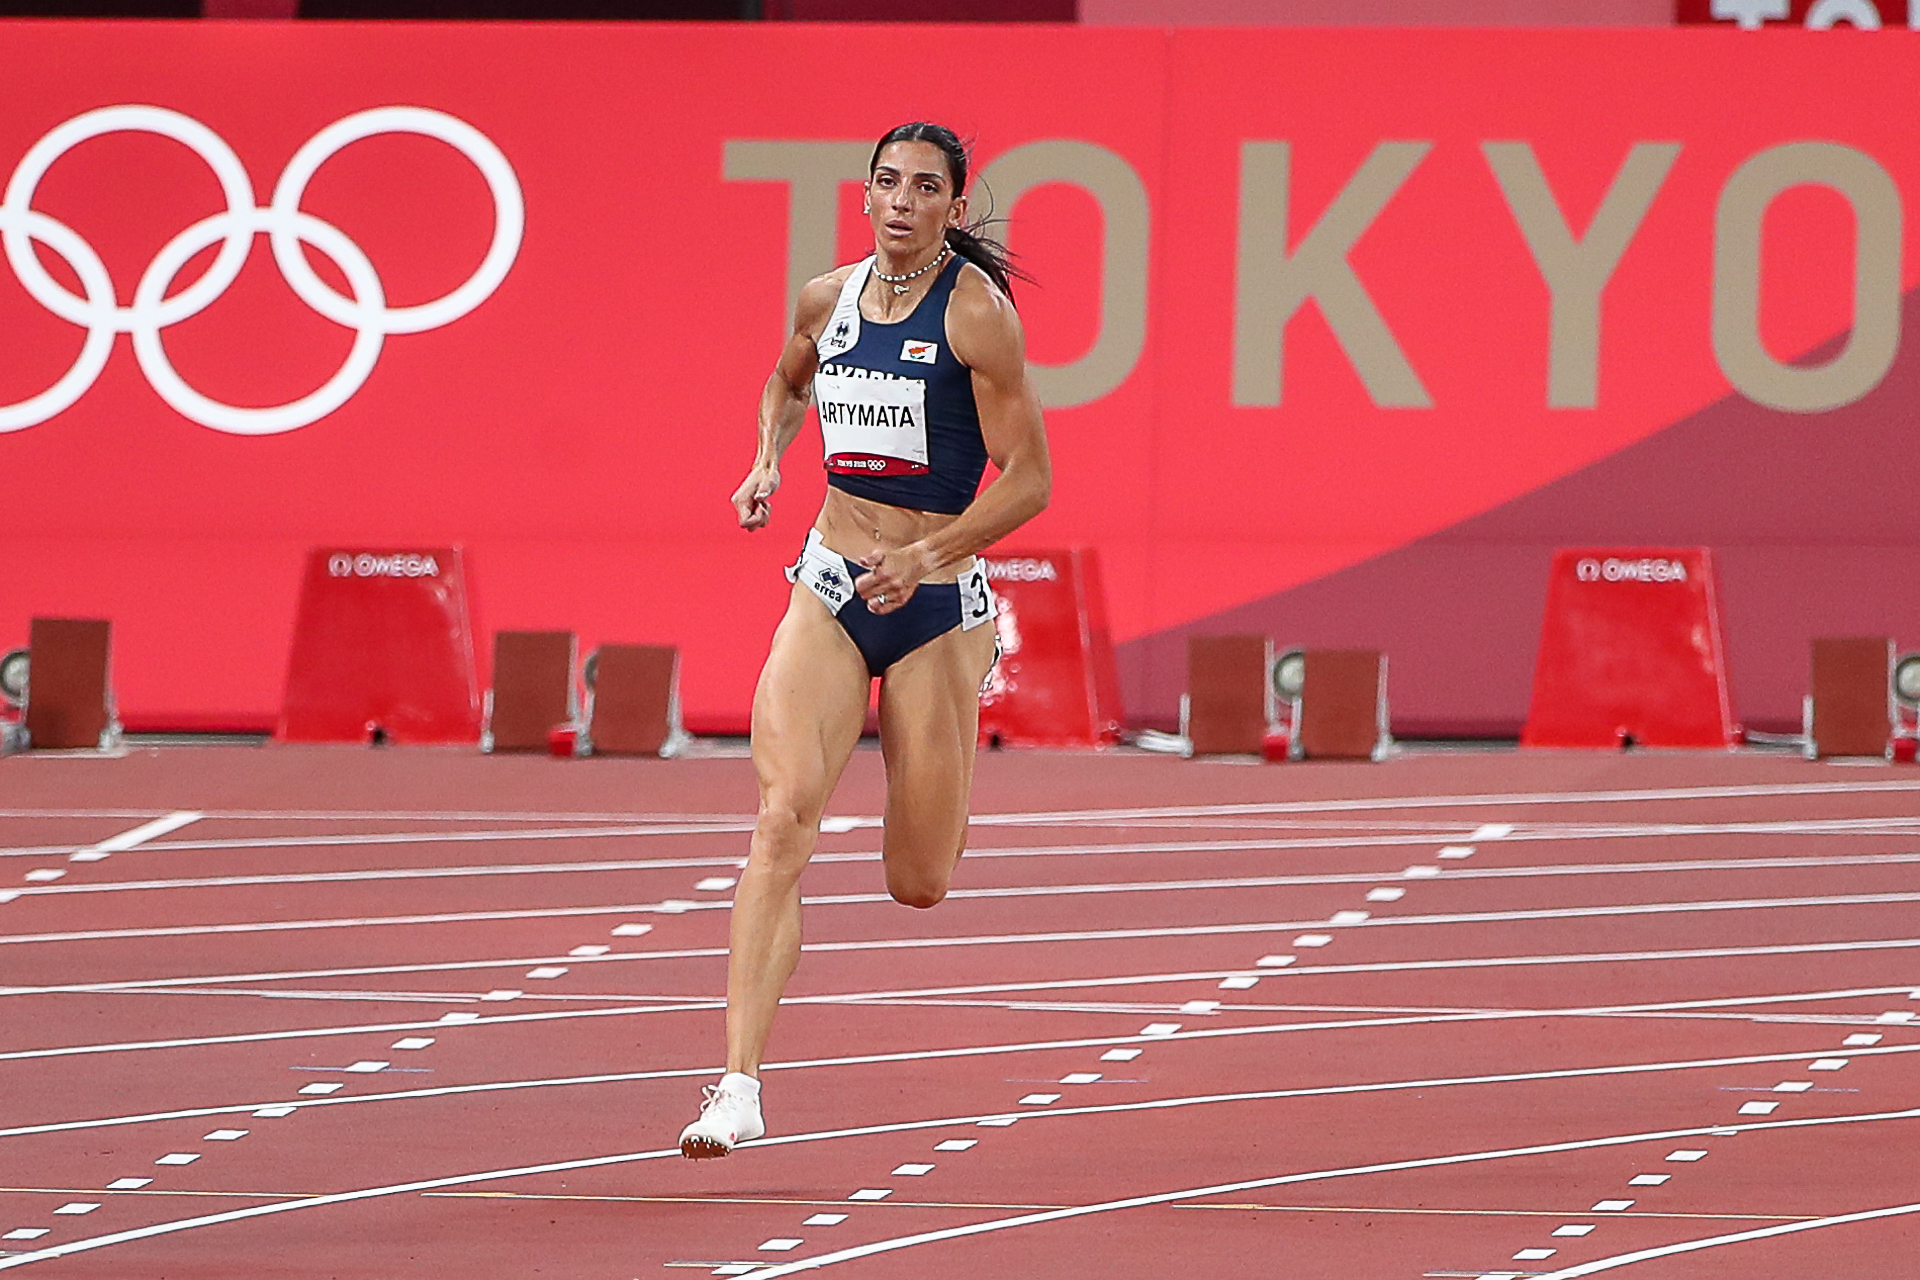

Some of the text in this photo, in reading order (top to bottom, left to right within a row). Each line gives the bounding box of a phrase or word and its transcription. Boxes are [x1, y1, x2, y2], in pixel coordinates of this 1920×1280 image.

[721, 138, 1904, 414] TOKYO
[822, 401, 915, 428] ARTYMATA
[353, 553, 440, 577] OMEGA
[985, 558, 1058, 582] MEGA
[1602, 557, 1688, 582] OMEGA
[814, 581, 843, 603] errea
[970, 572, 989, 619] 3
